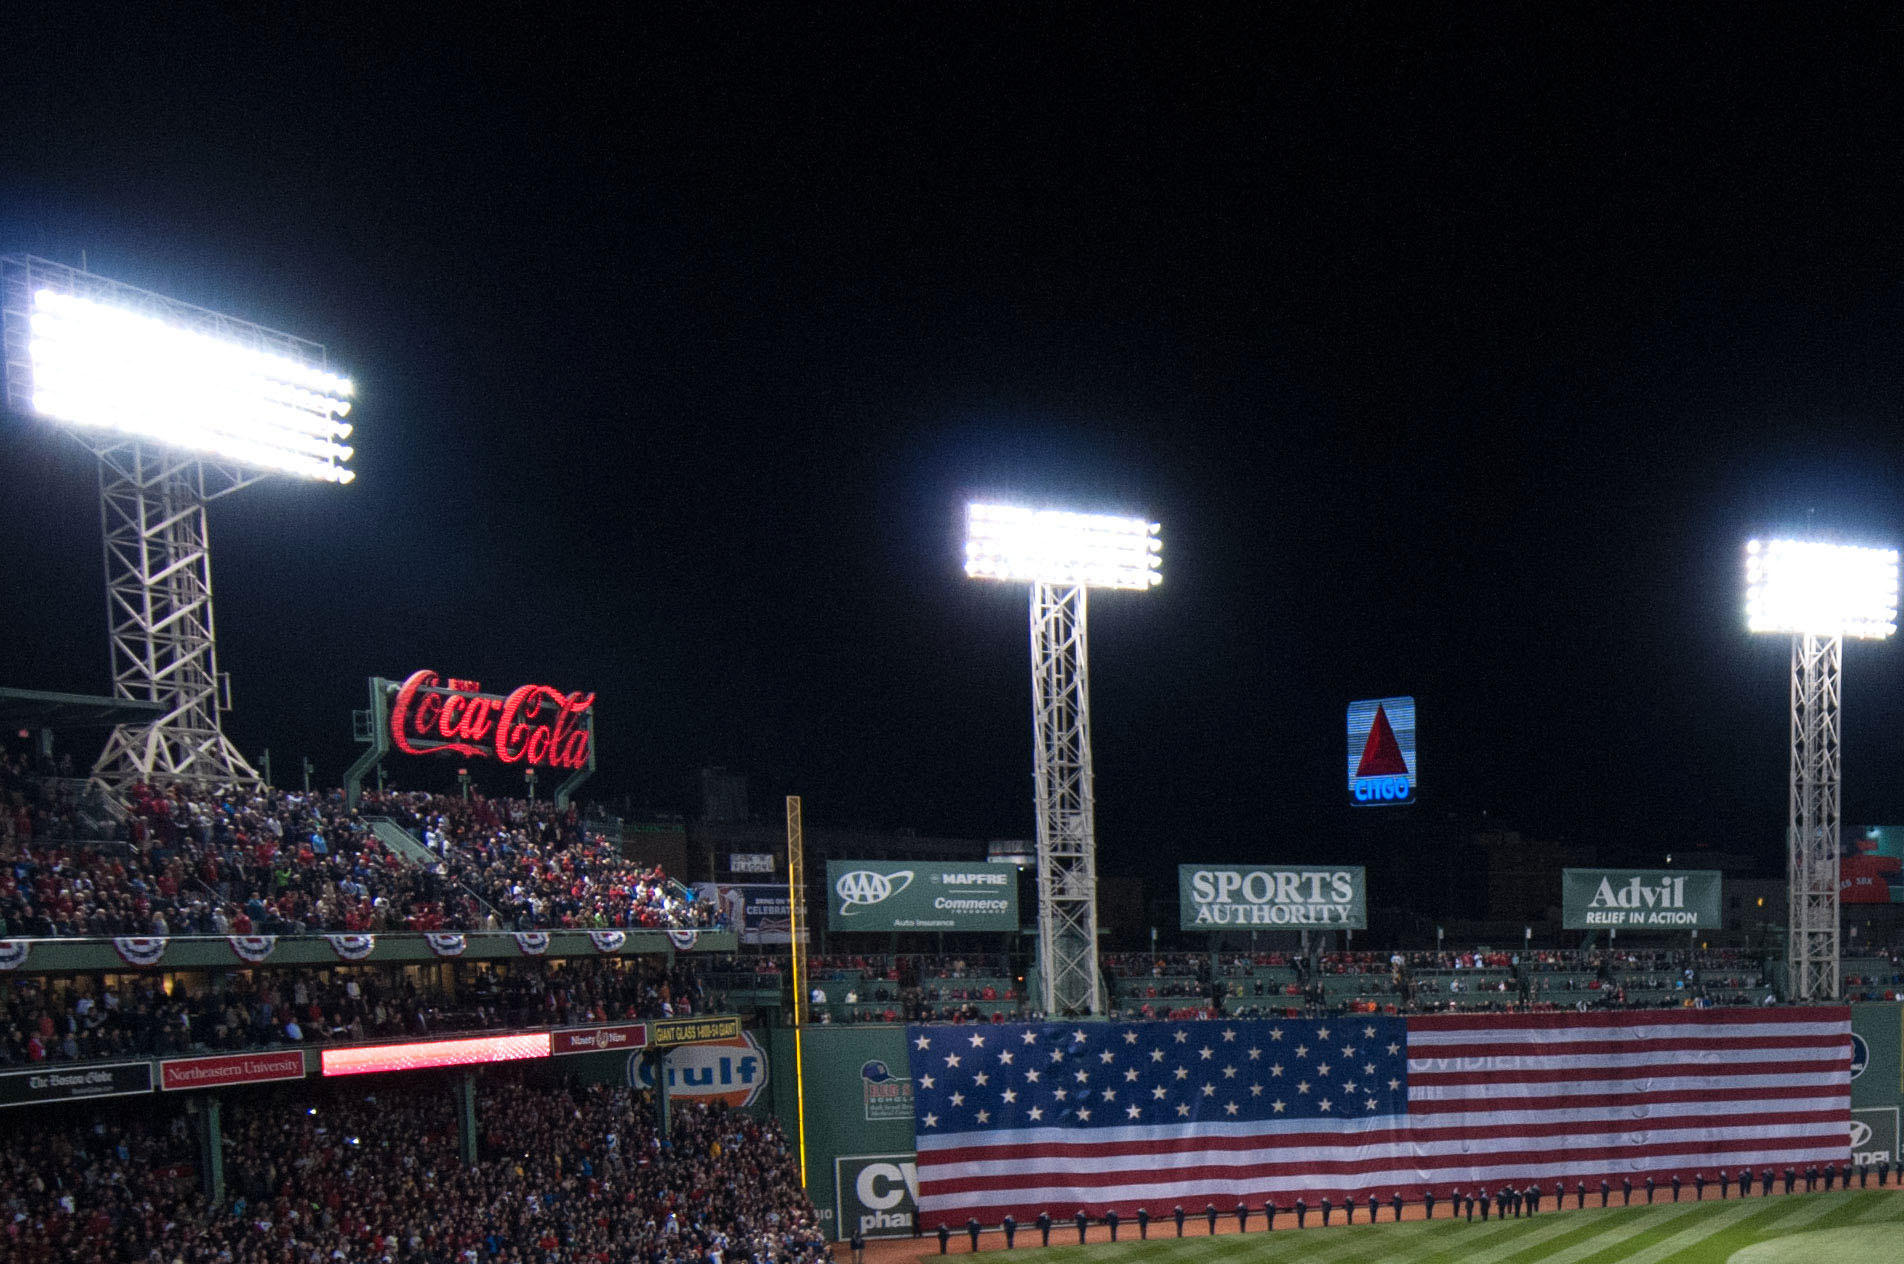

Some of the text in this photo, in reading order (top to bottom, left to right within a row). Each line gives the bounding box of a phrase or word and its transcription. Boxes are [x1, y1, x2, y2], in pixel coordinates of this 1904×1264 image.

[1355, 776, 1410, 801] CITGO
[844, 872, 887, 903] AAA
[942, 873, 1008, 885] MAPFRE
[1192, 870, 1353, 904] SPORTS
[1587, 875, 1685, 908] Advil
[747, 906, 808, 915] CELEBRATON
[934, 897, 1008, 910] Commerce
[893, 919, 955, 927] Auto Insurance
[1194, 904, 1352, 924] AUTHORITY
[1586, 912, 1698, 924] RELIEF IN ACTION
[656, 1026, 675, 1041] GIANT
[676, 1025, 696, 1040] GLASS
[719, 1022, 736, 1036] GIANT
[49, 1074, 83, 1086] Boston
[168, 1060, 299, 1083] Northeastern University
